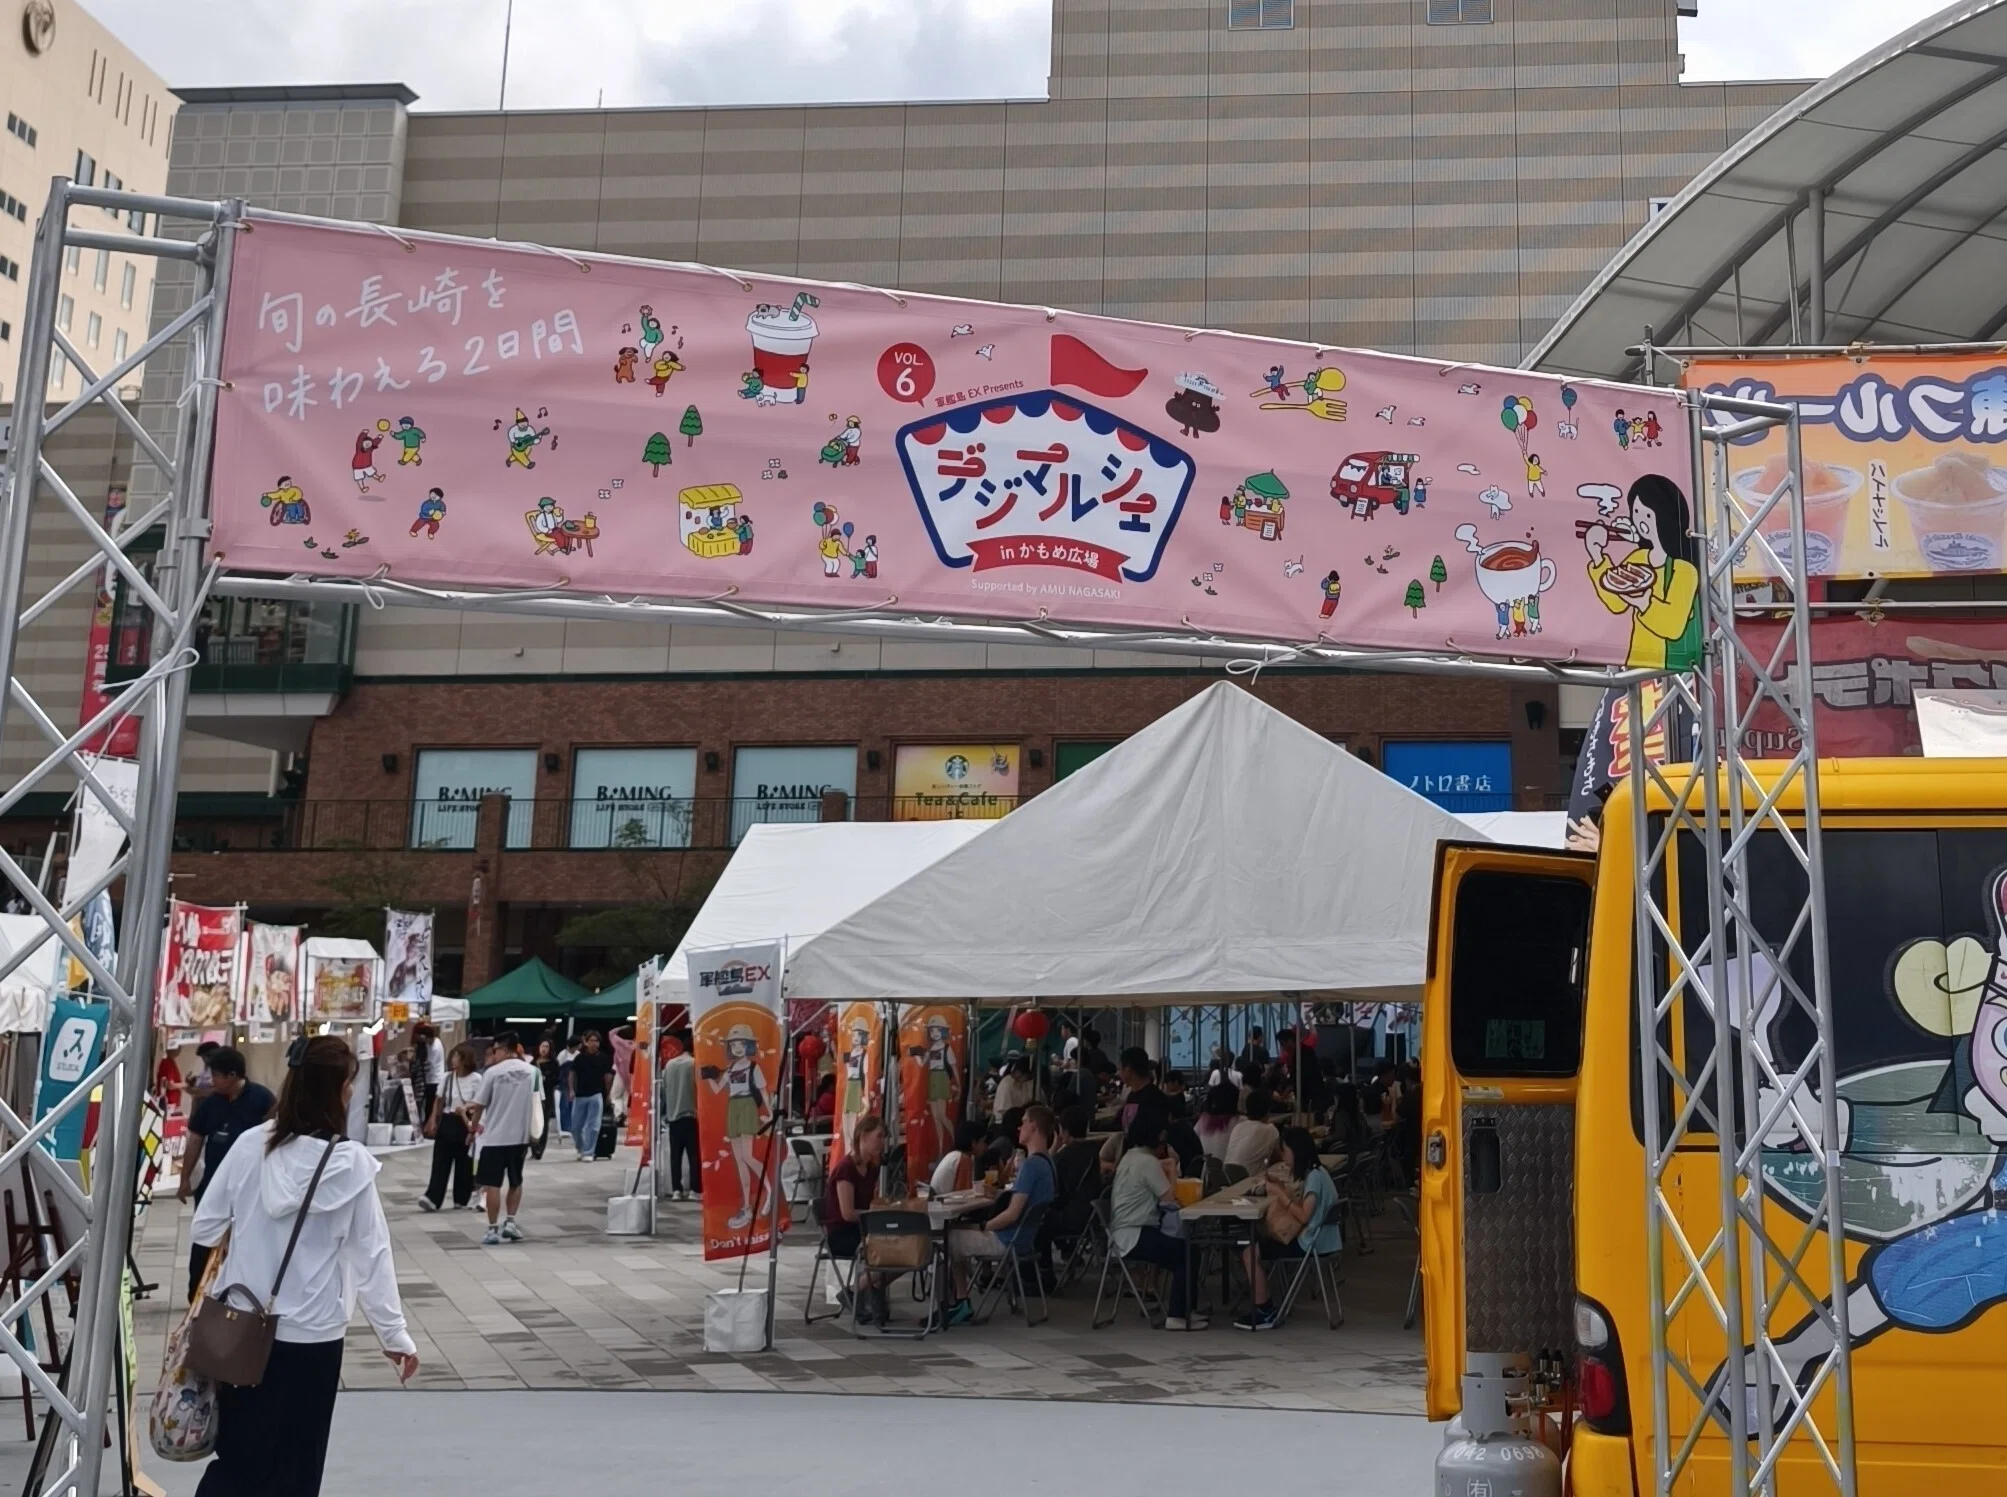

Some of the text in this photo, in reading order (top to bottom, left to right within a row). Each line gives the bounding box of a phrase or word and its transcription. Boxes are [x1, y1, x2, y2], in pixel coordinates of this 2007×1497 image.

[259, 267, 507, 353] 旬の長崎を
[263, 308, 585, 421] 味わえる2日間
[895, 368, 916, 396] 6
[967, 387, 982, 399] EX
[983, 379, 1024, 395] Presents
[937, 442, 1158, 533] デジマルシェ
[999, 542, 1100, 569] in かもめ広場
[971, 579, 1121, 599] Supported by AMU NAGASAKI
